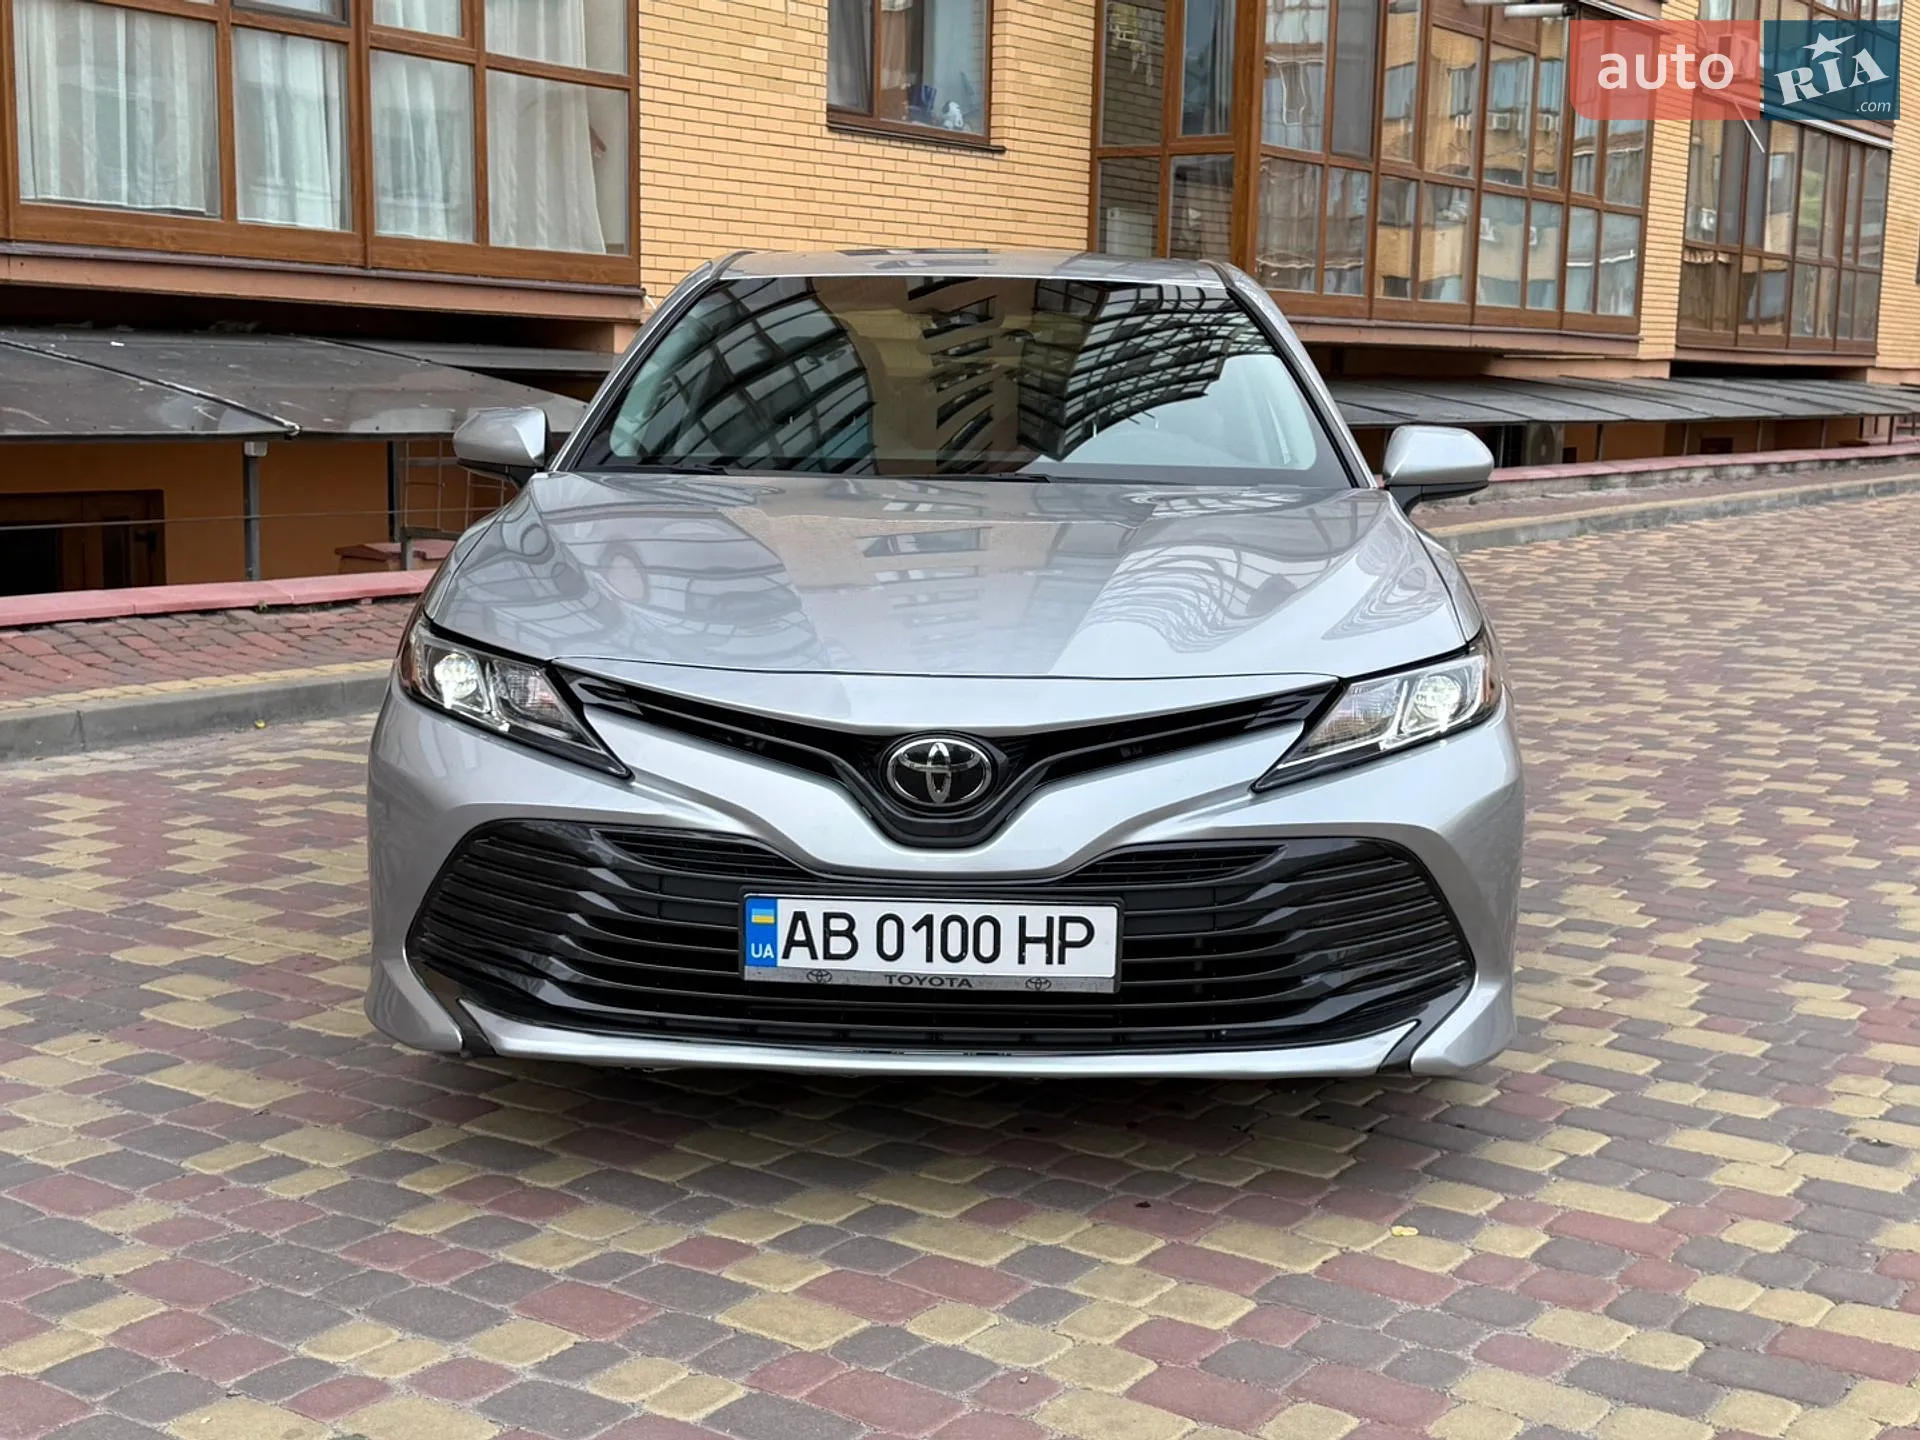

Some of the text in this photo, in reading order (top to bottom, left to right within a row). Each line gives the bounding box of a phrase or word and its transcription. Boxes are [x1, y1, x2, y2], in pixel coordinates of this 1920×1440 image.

[781, 910, 1096, 966] AB 0100 HP
[751, 943, 775, 959] UA
[884, 974, 973, 989] TOYOTA
